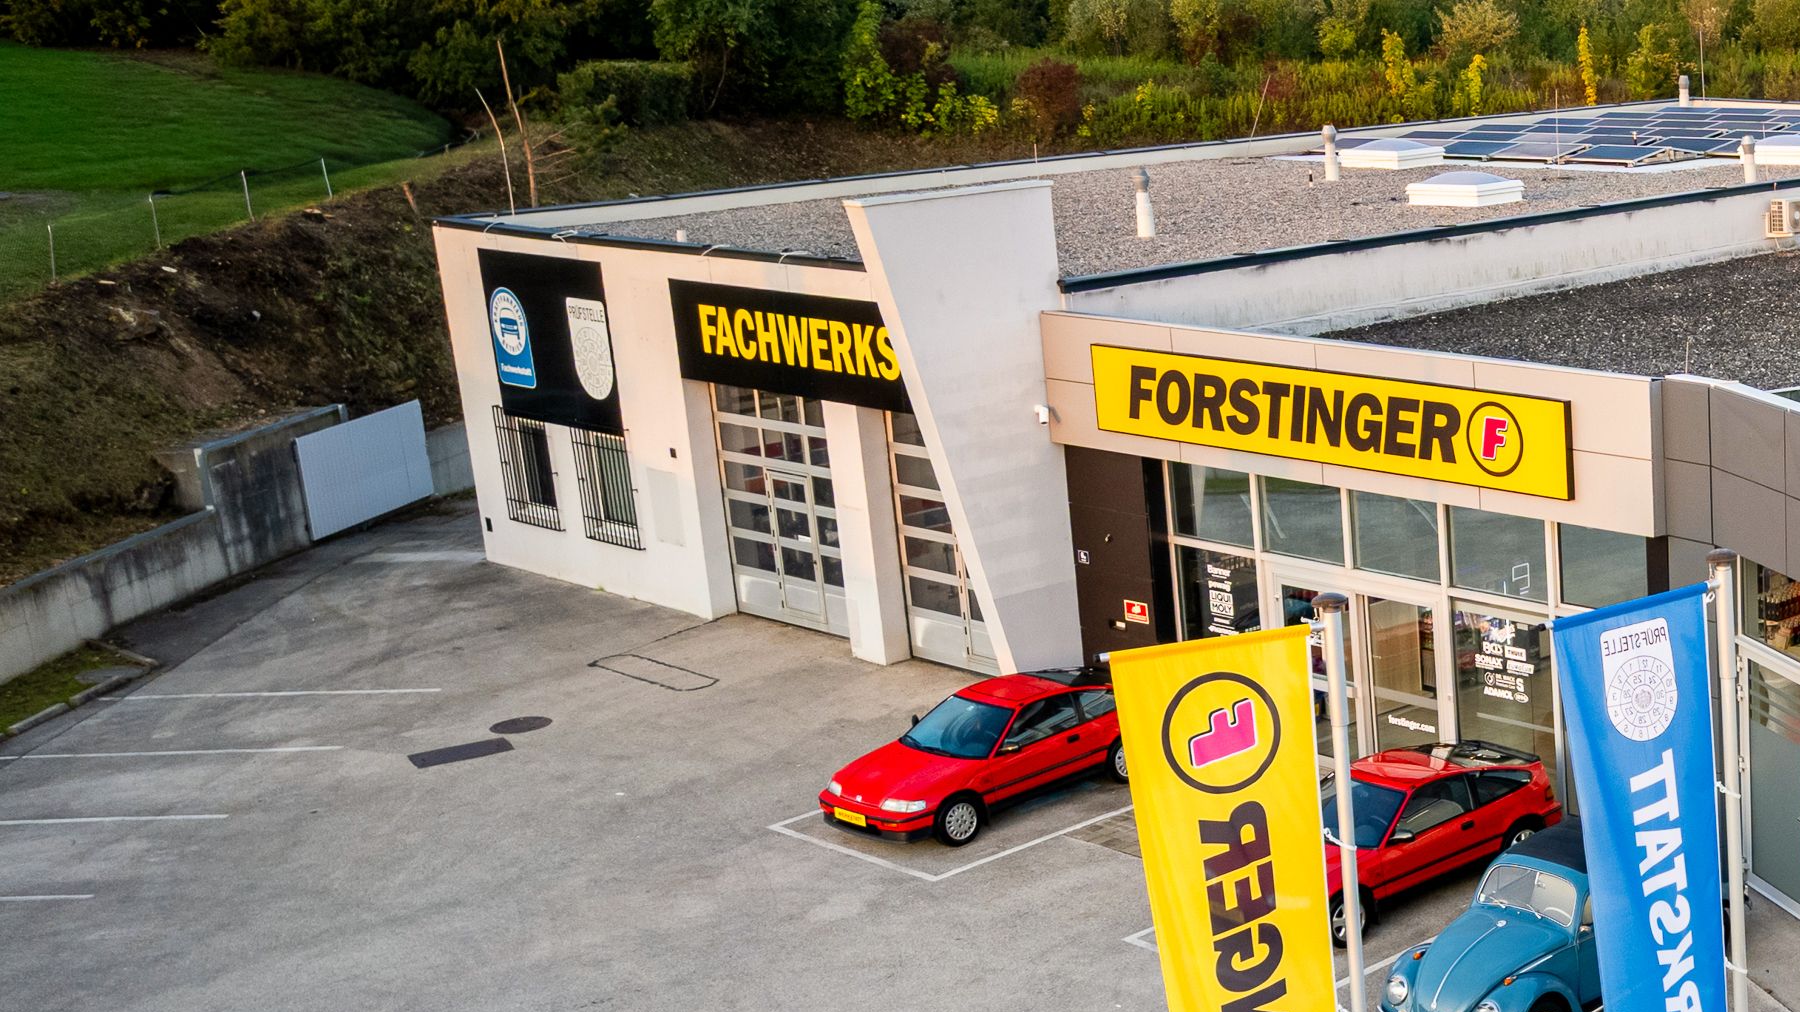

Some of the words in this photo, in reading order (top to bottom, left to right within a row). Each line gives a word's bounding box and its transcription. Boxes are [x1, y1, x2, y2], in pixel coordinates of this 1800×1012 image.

[568, 305, 605, 323] PRÜFSTELLE
[698, 304, 900, 381] FACHWERKS
[1129, 365, 1460, 464] FORSTINGER
[1481, 416, 1509, 460] F
[1211, 591, 1232, 602] LIQUI
[1212, 603, 1232, 613] MOLY
[1388, 714, 1436, 733] forstinger.com
